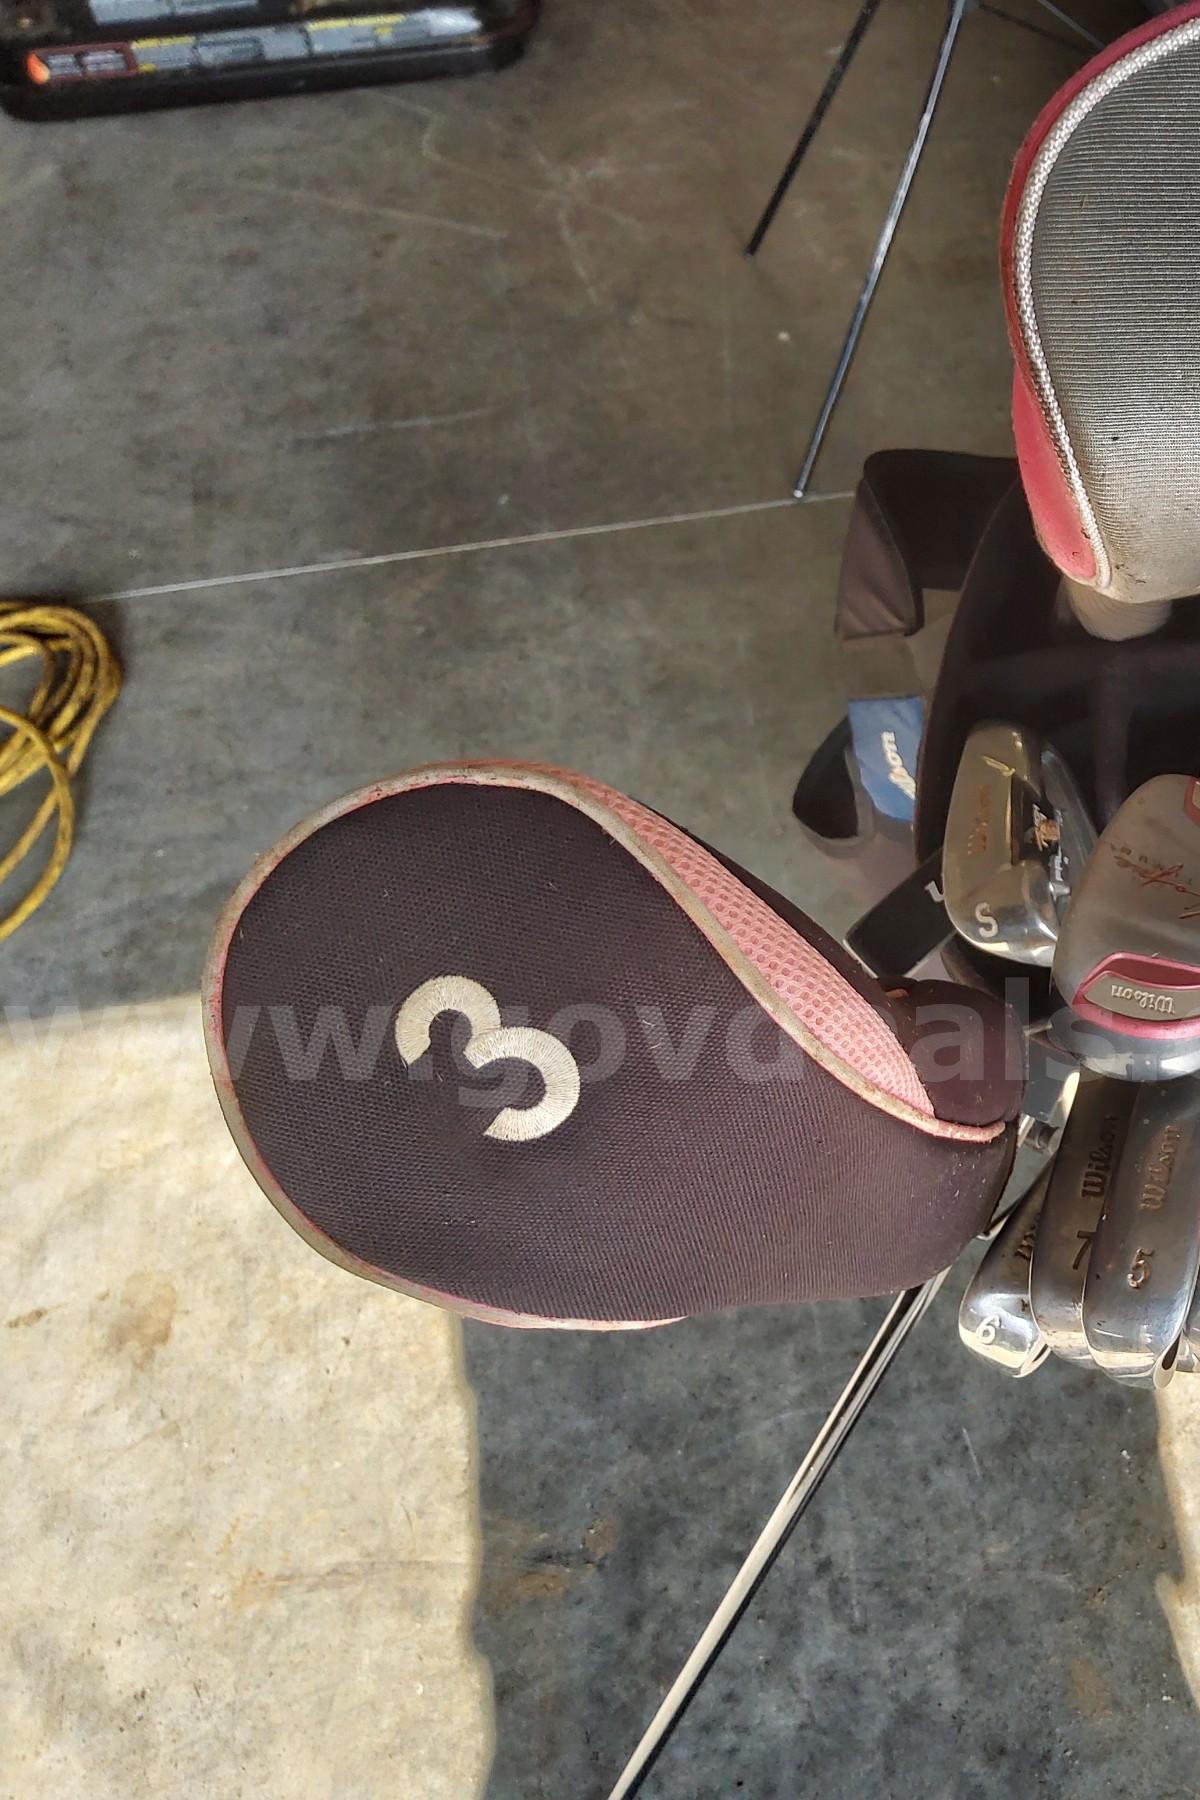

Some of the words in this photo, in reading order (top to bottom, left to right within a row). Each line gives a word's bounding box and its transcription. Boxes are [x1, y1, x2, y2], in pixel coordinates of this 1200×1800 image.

[975, 902, 999, 938] S
[1111, 984, 1176, 1015] Wilson
[395, 975, 580, 1141] 3
[1081, 1114, 1119, 1200] Wilson
[1072, 1230, 1096, 1271] 7
[1127, 1248, 1154, 1289] 5
[974, 1315, 1001, 1345] 6
